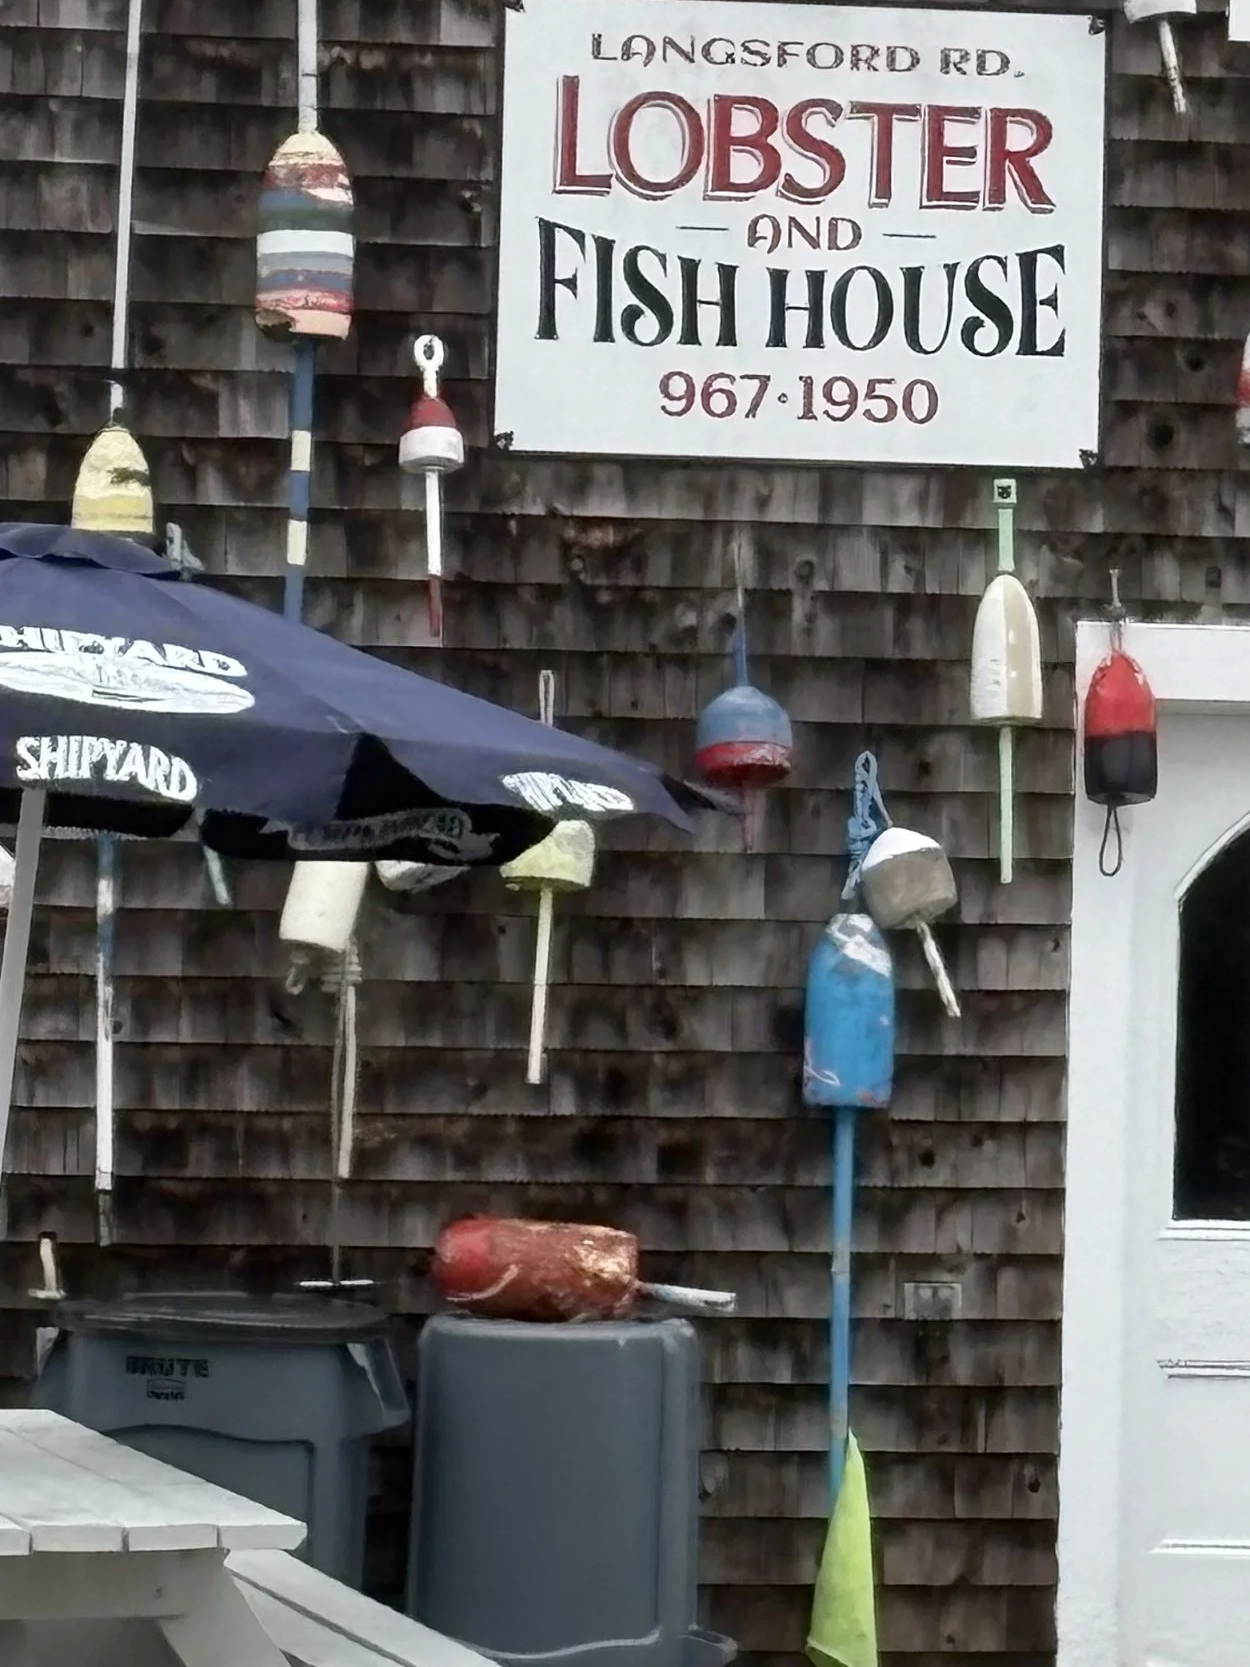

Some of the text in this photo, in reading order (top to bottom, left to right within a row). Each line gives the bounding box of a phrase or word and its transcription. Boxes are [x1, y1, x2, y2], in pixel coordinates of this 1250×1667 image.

[591, 32, 1024, 77] LANGSFORD RD.
[552, 75, 1056, 214] LOBSTER
[746, 214, 863, 254] AND
[534, 215, 1066, 358] FISH HOUSE
[0, 625, 247, 677] HIPYARD
[16, 735, 198, 802] SHIPYARD
